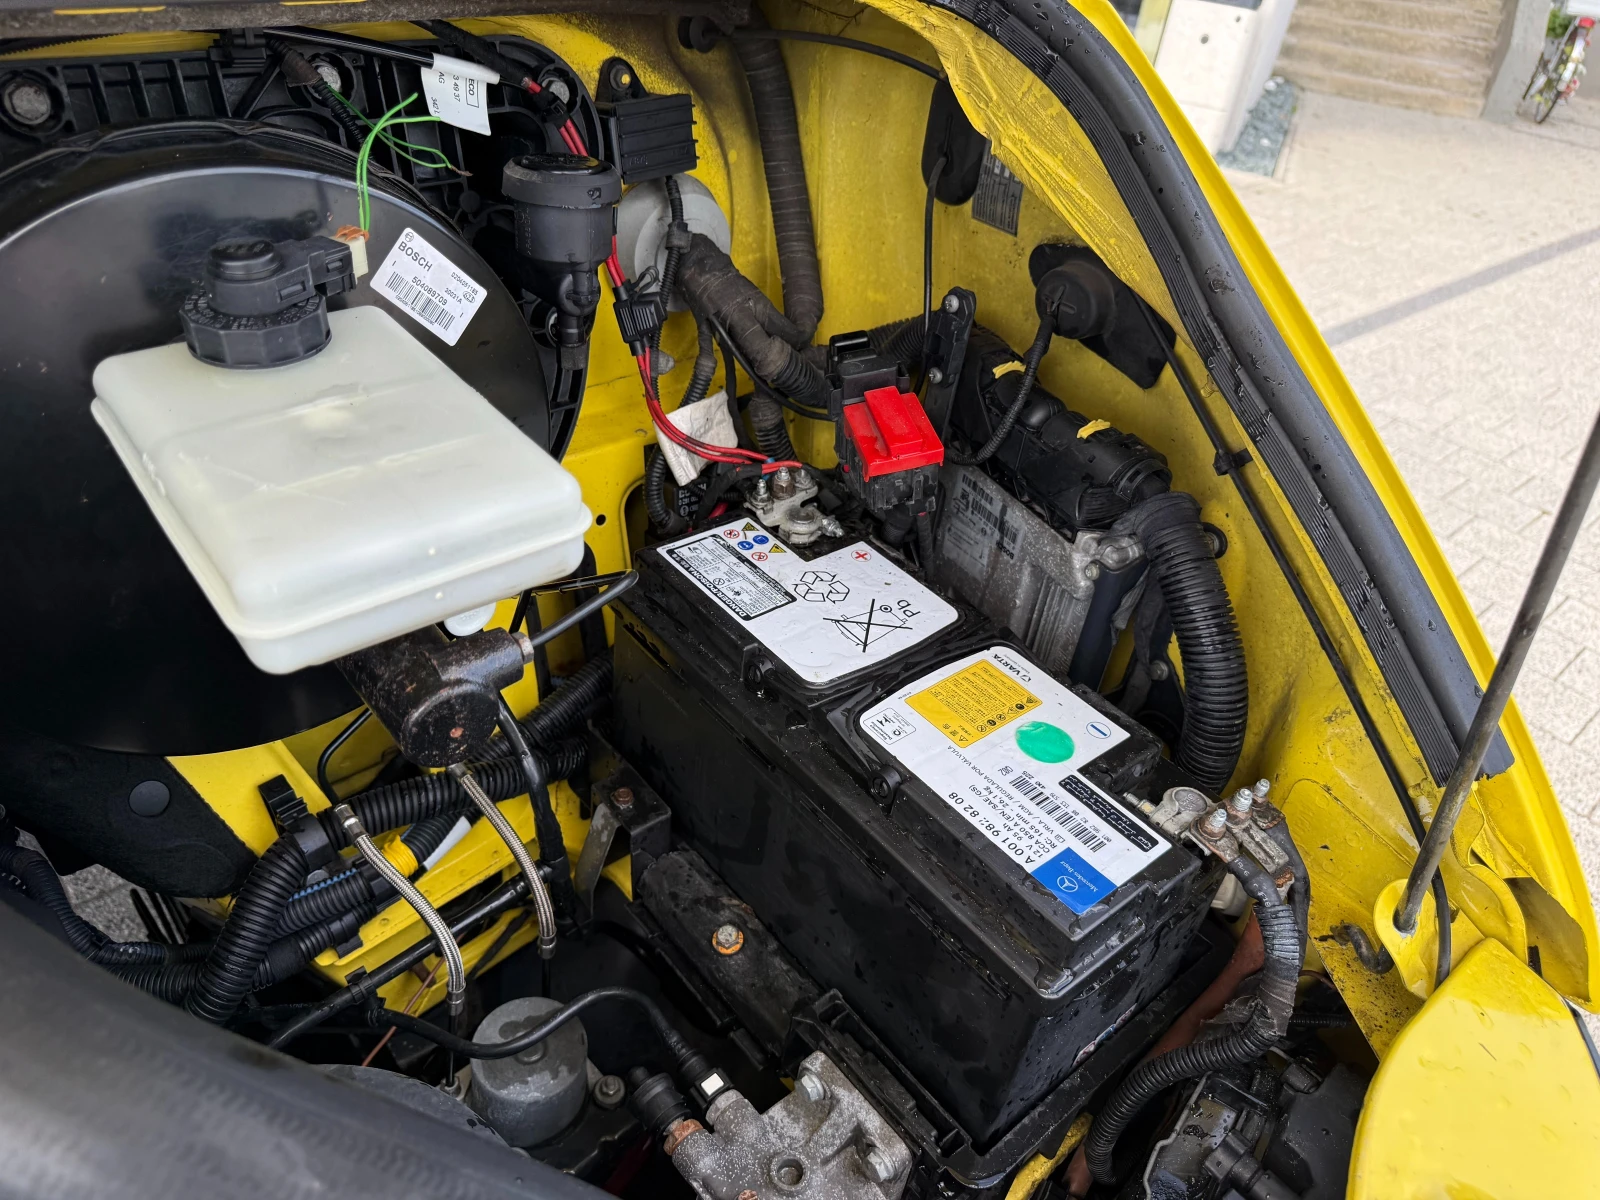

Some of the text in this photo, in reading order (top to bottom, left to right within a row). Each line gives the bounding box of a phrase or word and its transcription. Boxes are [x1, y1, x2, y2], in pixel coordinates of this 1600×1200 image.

[438, 71, 445, 84] AG
[452, 81, 459, 91] 49
[453, 92, 460, 102] 37
[397, 240, 433, 272] BOSCH
[410, 275, 448, 306] 504089709
[894, 599, 921, 618] Pb
[991, 652, 1021, 676] VARTA
[970, 764, 984, 776] POR
[982, 774, 1014, 801] REGULADA
[982, 784, 994, 795] kg
[947, 790, 964, 805] 08
[967, 783, 1014, 822] (EN/SAE/GS)
[991, 792, 1010, 808] 26,1
[962, 803, 980, 818] 82
[1016, 802, 1034, 815] AGM
[1014, 812, 1030, 825] min
[1001, 822, 1013, 832] Ah
[1017, 826, 1035, 840] 850
[1027, 823, 1044, 837] 165
[1037, 818, 1053, 834] VRLA
[1011, 831, 1023, 841] 95
[1042, 836, 1058, 849] RC:
[1000, 836, 1025, 857] 001
[1033, 838, 1051, 853] CCA
[1023, 854, 1035, 864] A
[1032, 848, 1044, 858] 12
[1058, 859, 1098, 892] Mercedes-Benz
